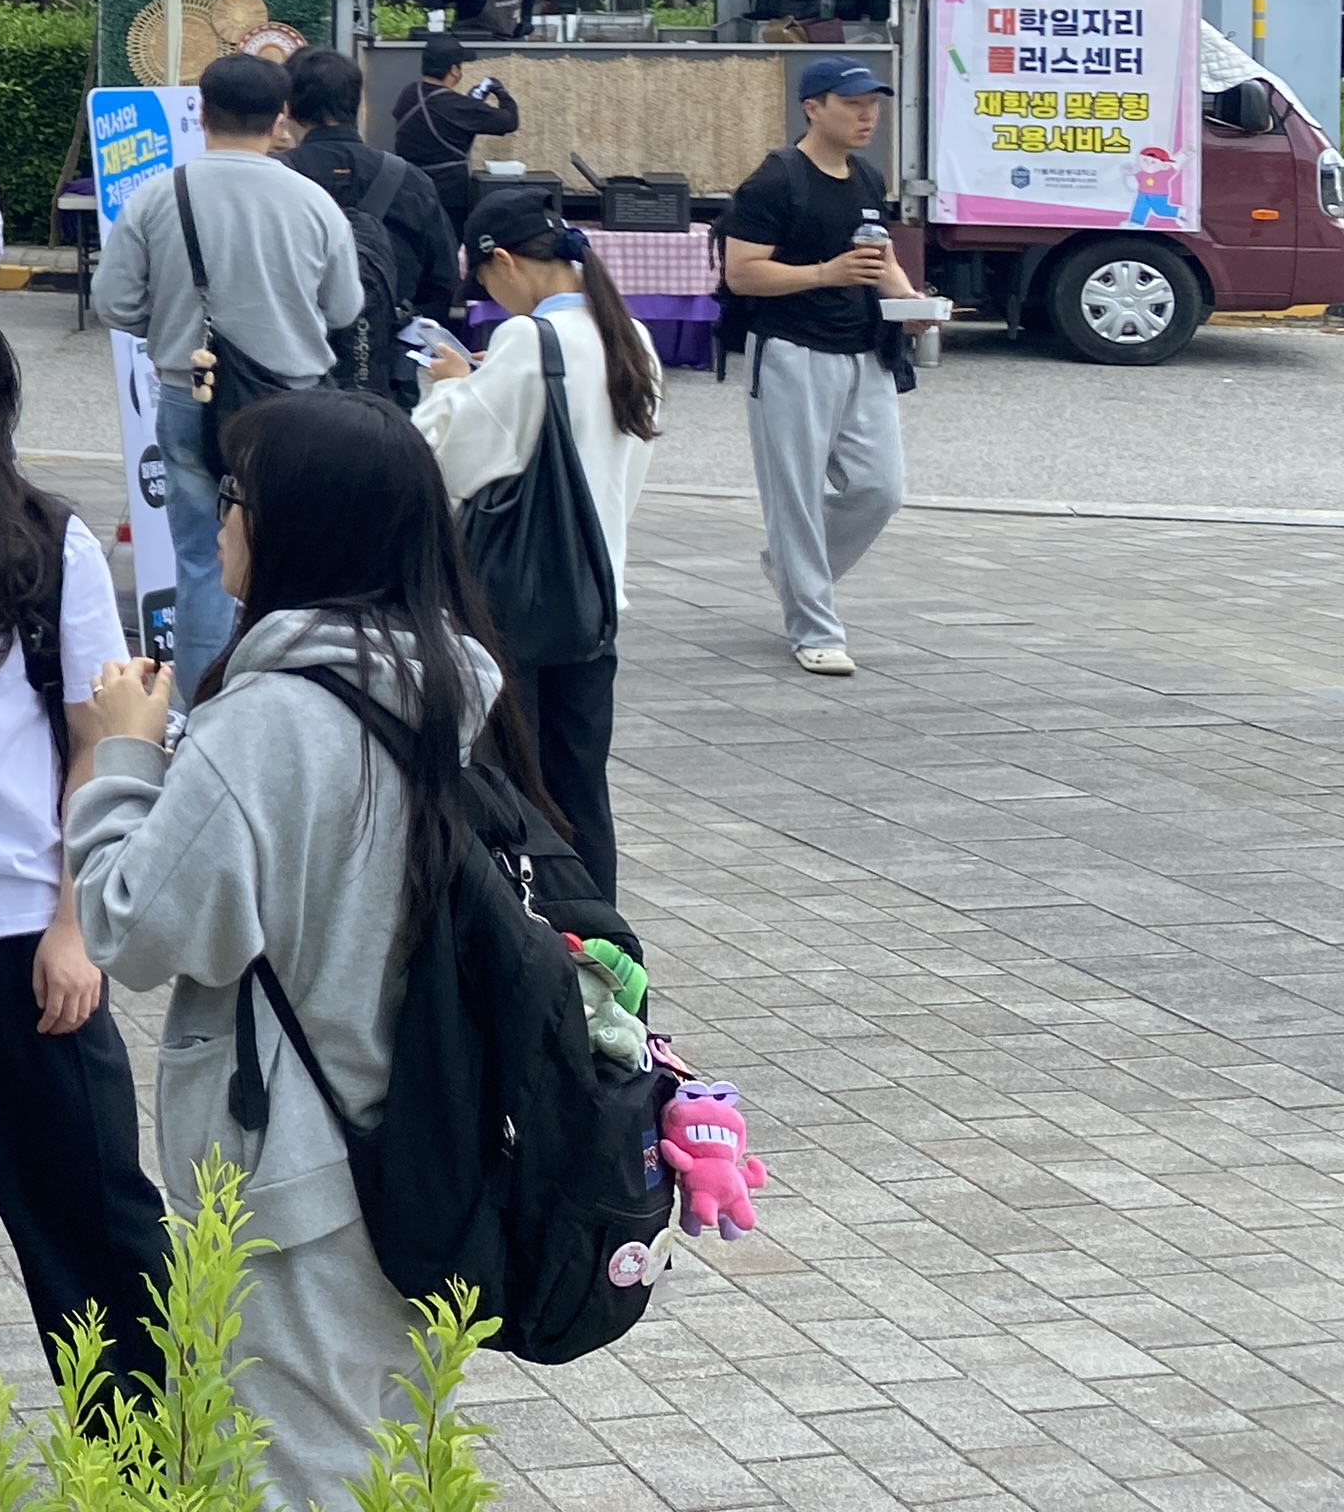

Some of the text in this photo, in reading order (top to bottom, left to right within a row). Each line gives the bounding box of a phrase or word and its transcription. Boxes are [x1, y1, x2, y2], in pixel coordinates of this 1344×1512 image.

[987, 8, 1144, 37] 대학일자리
[974, 90, 1150, 121] 재학생 맞춤형
[95, 103, 138, 140] 어서와
[992, 125, 1132, 154] 고용서비스
